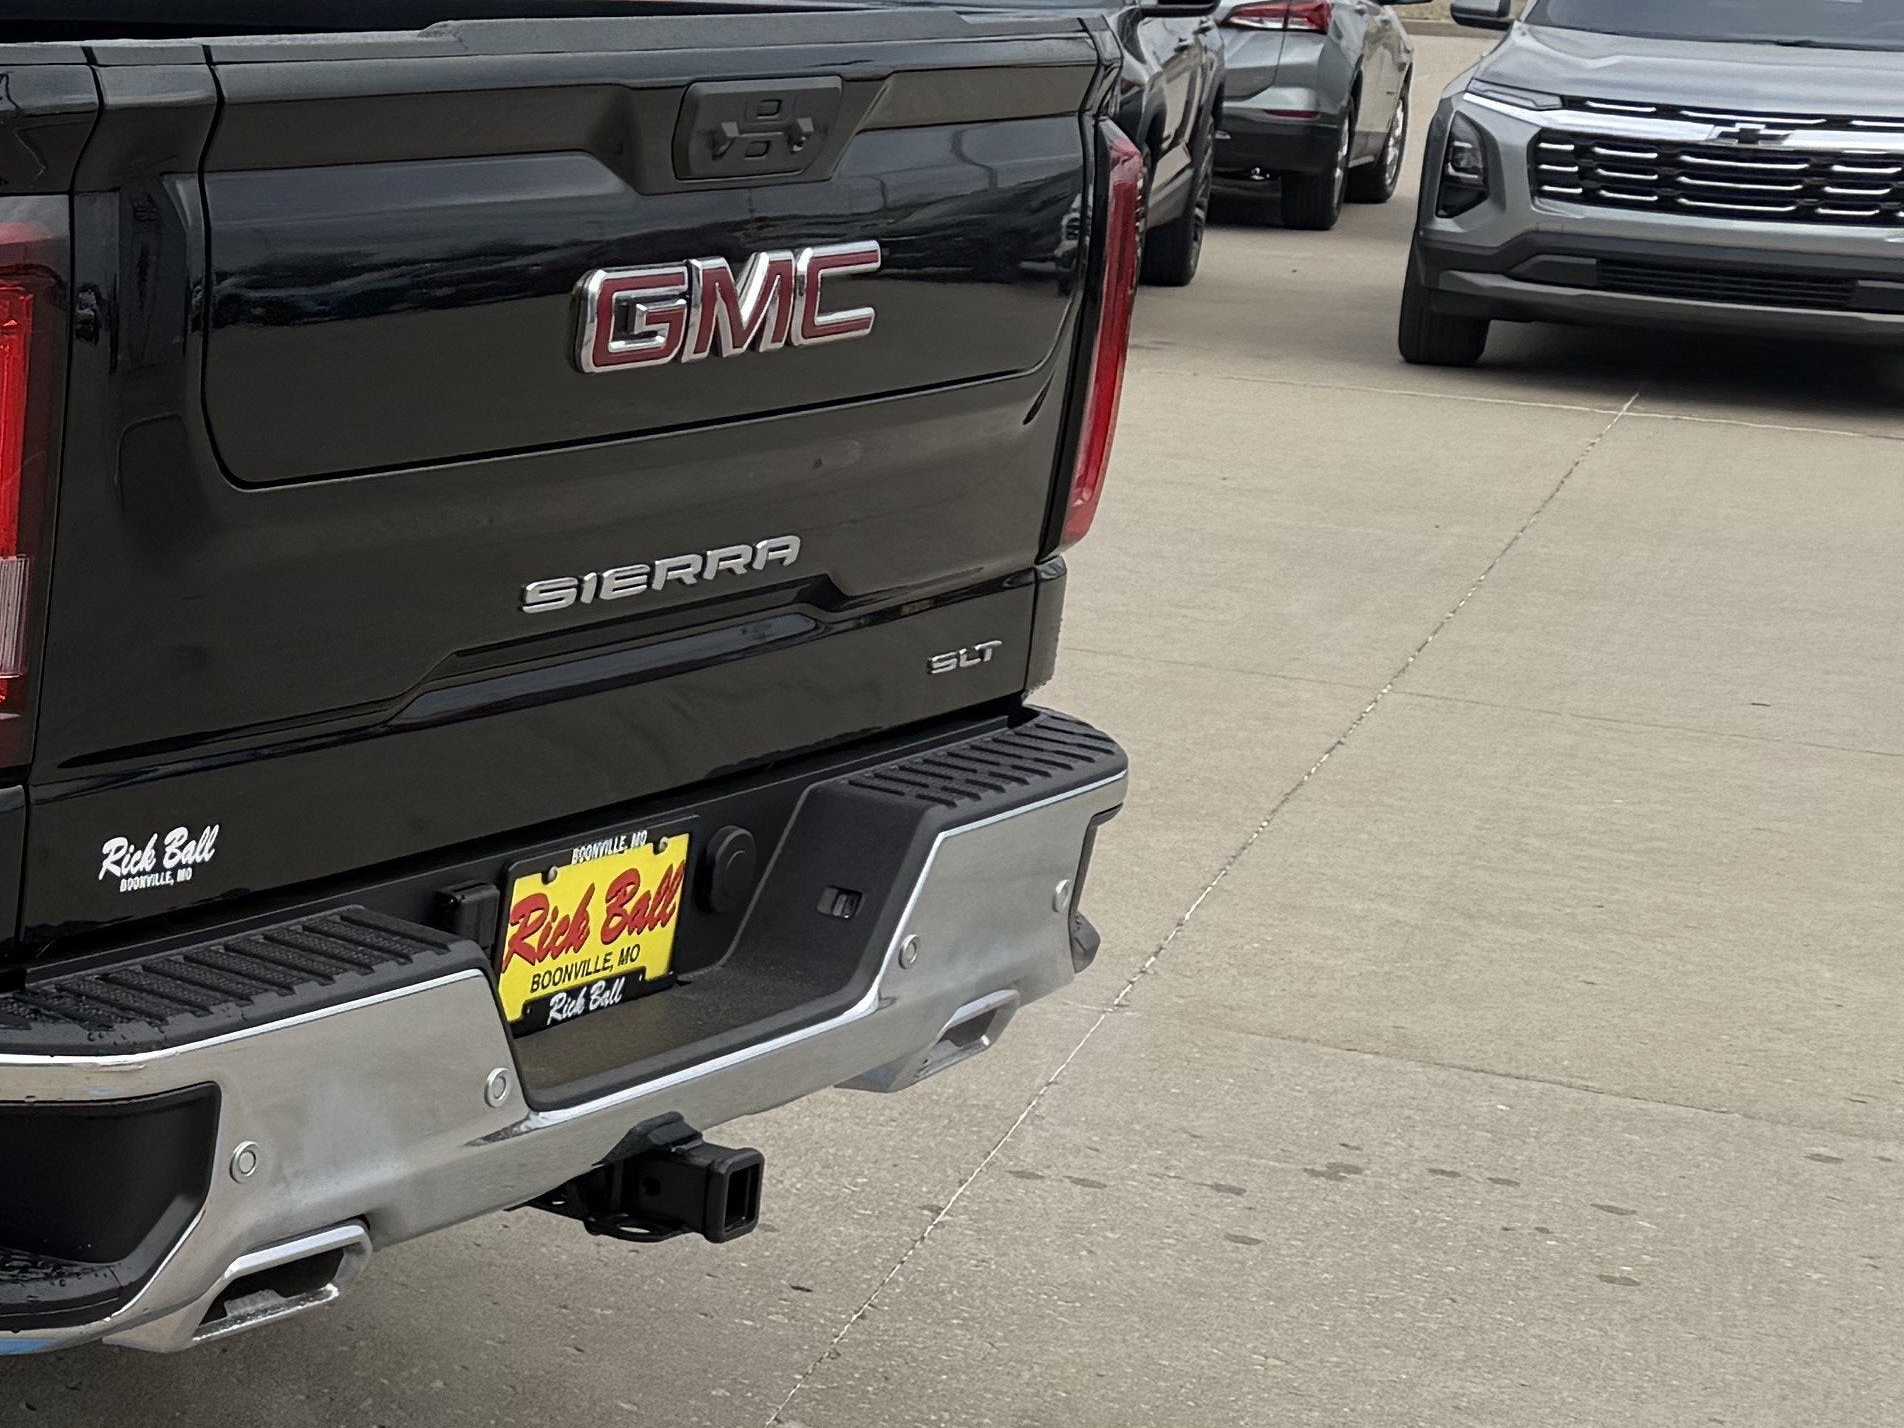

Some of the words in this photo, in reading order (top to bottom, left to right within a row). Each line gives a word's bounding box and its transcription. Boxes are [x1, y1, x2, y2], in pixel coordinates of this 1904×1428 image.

[571, 240, 882, 373] GMC
[520, 534, 802, 613] SIERRA
[927, 639, 1002, 674] SLT
[98, 833, 158, 880] Rick
[163, 824, 220, 868] Ball
[631, 829, 648, 847] MO
[176, 867, 193, 882] MO
[502, 882, 596, 974] Rick
[600, 860, 687, 945] Ball
[530, 951, 614, 994] BOONVILLE,
[618, 943, 641, 967] MO
[547, 985, 587, 1025] Rick
[589, 977, 626, 1011] Ball
